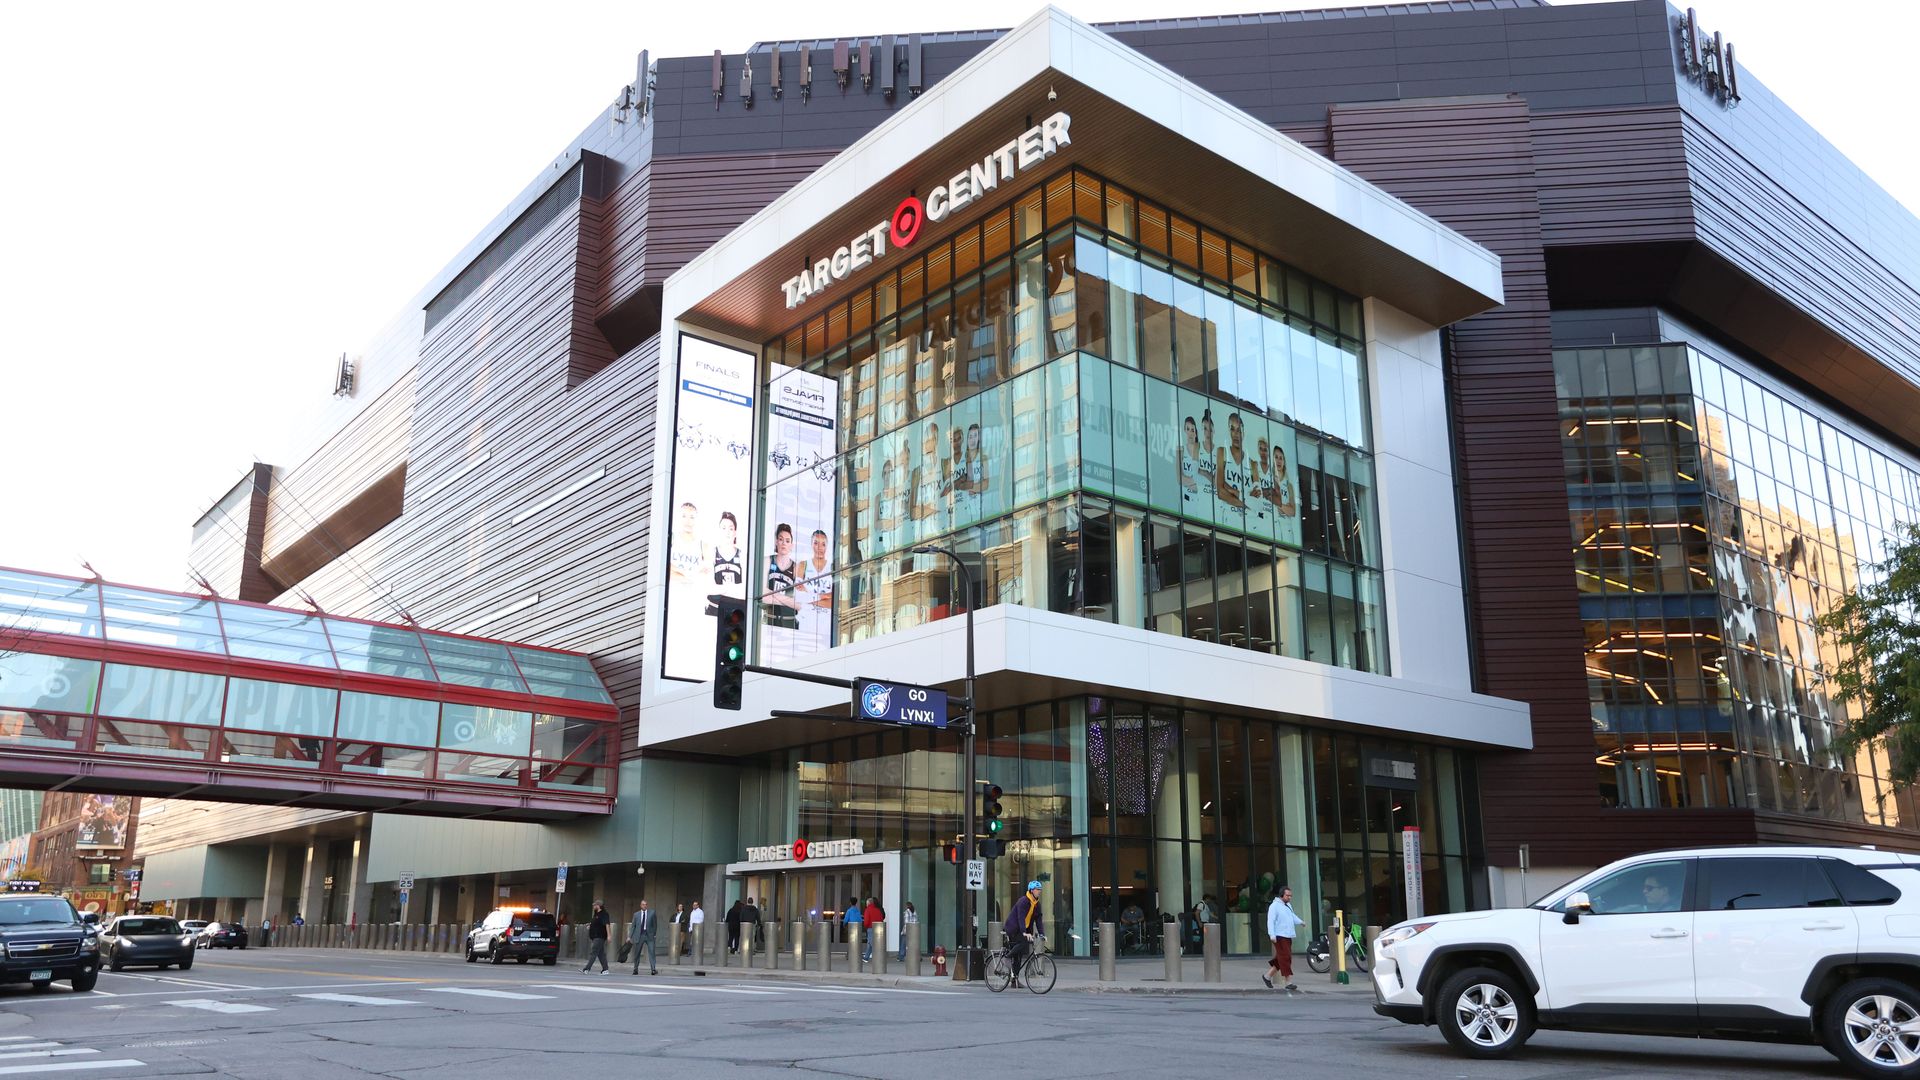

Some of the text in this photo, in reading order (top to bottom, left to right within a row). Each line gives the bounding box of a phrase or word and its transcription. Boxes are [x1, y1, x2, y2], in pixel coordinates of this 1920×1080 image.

[780, 111, 1072, 311] TARGET CENTER
[695, 361, 740, 379] FINALS
[1183, 462, 1192, 472] LY
[1226, 469, 1252, 488] LYNX
[1260, 477, 1273, 488] YNX
[672, 551, 700, 566] LYNX
[908, 688, 927, 702] GO
[900, 708, 935, 723] LYNX!
[746, 838, 864, 863] TARGET CENTER
[969, 862, 982, 870] ONE
